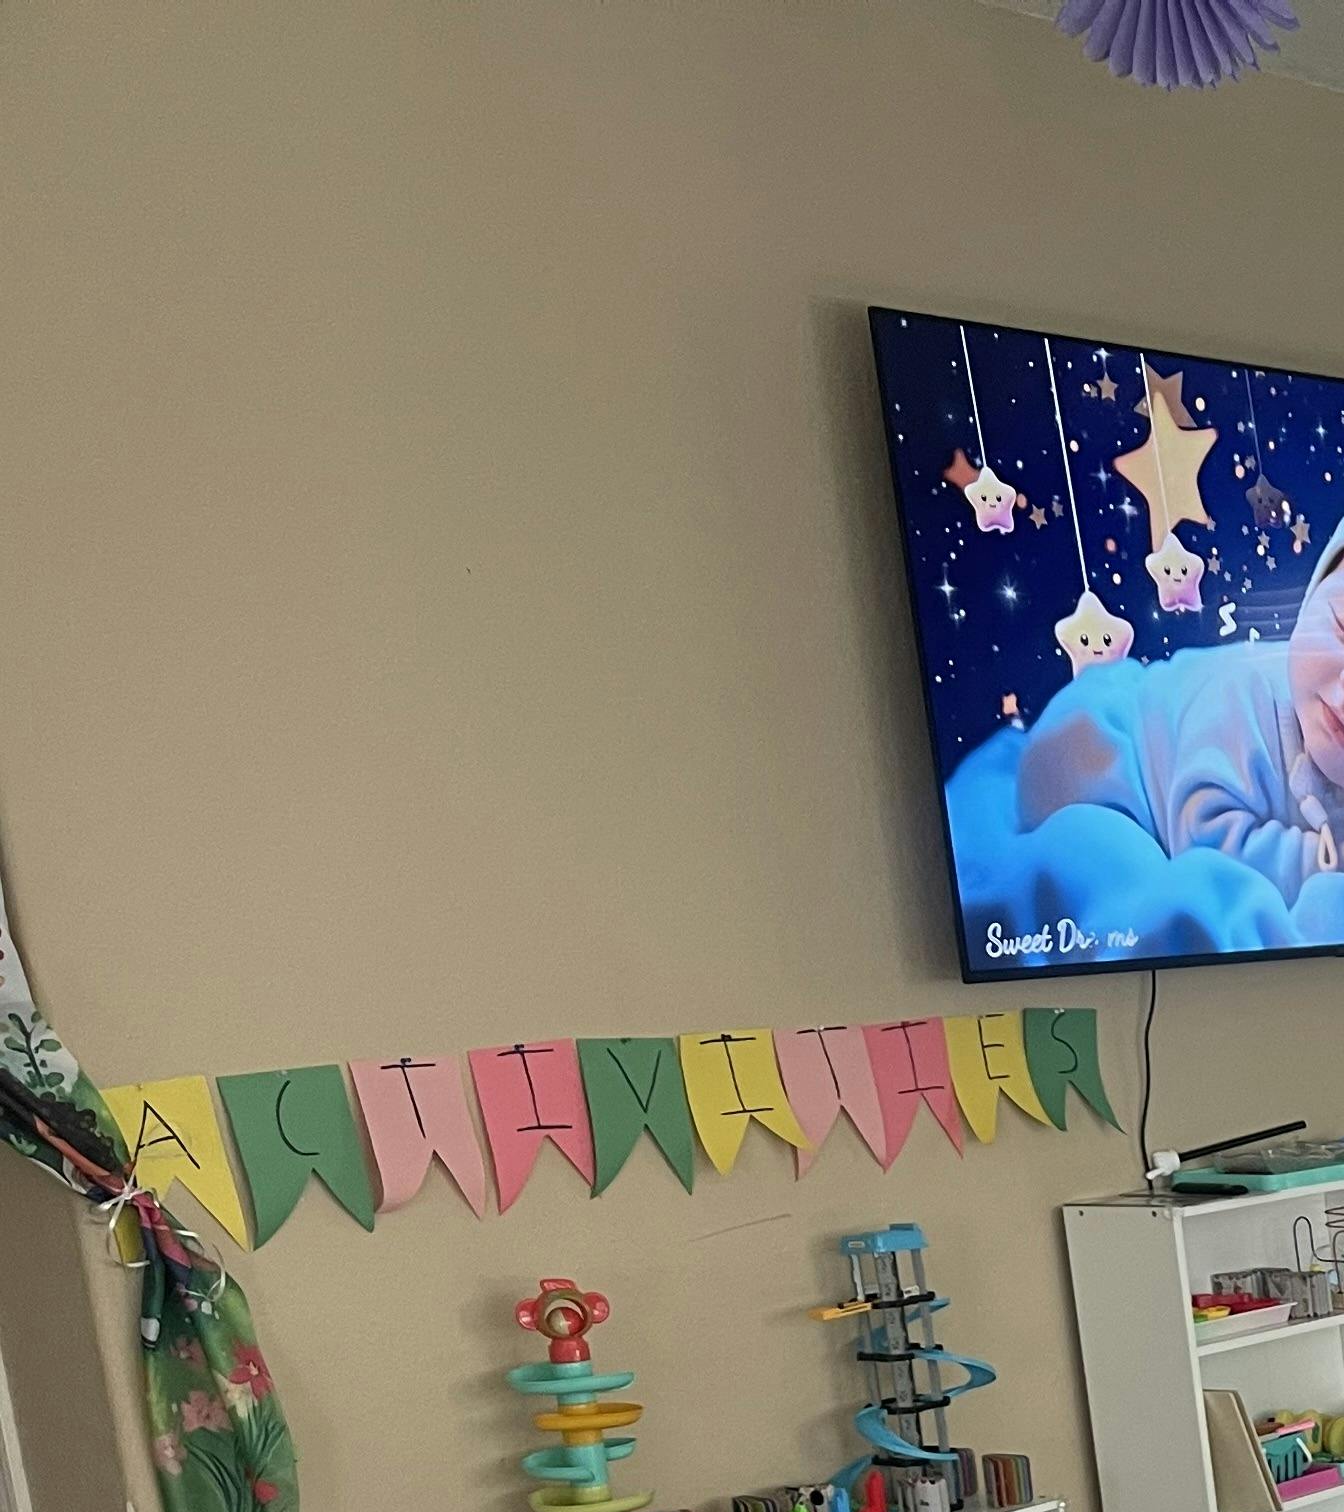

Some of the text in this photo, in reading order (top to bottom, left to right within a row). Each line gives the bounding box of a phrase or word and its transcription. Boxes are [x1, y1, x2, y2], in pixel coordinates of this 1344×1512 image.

[985, 917, 1139, 959] Sweet Drms
[132, 1011, 1080, 1173] ACTIVITIES
